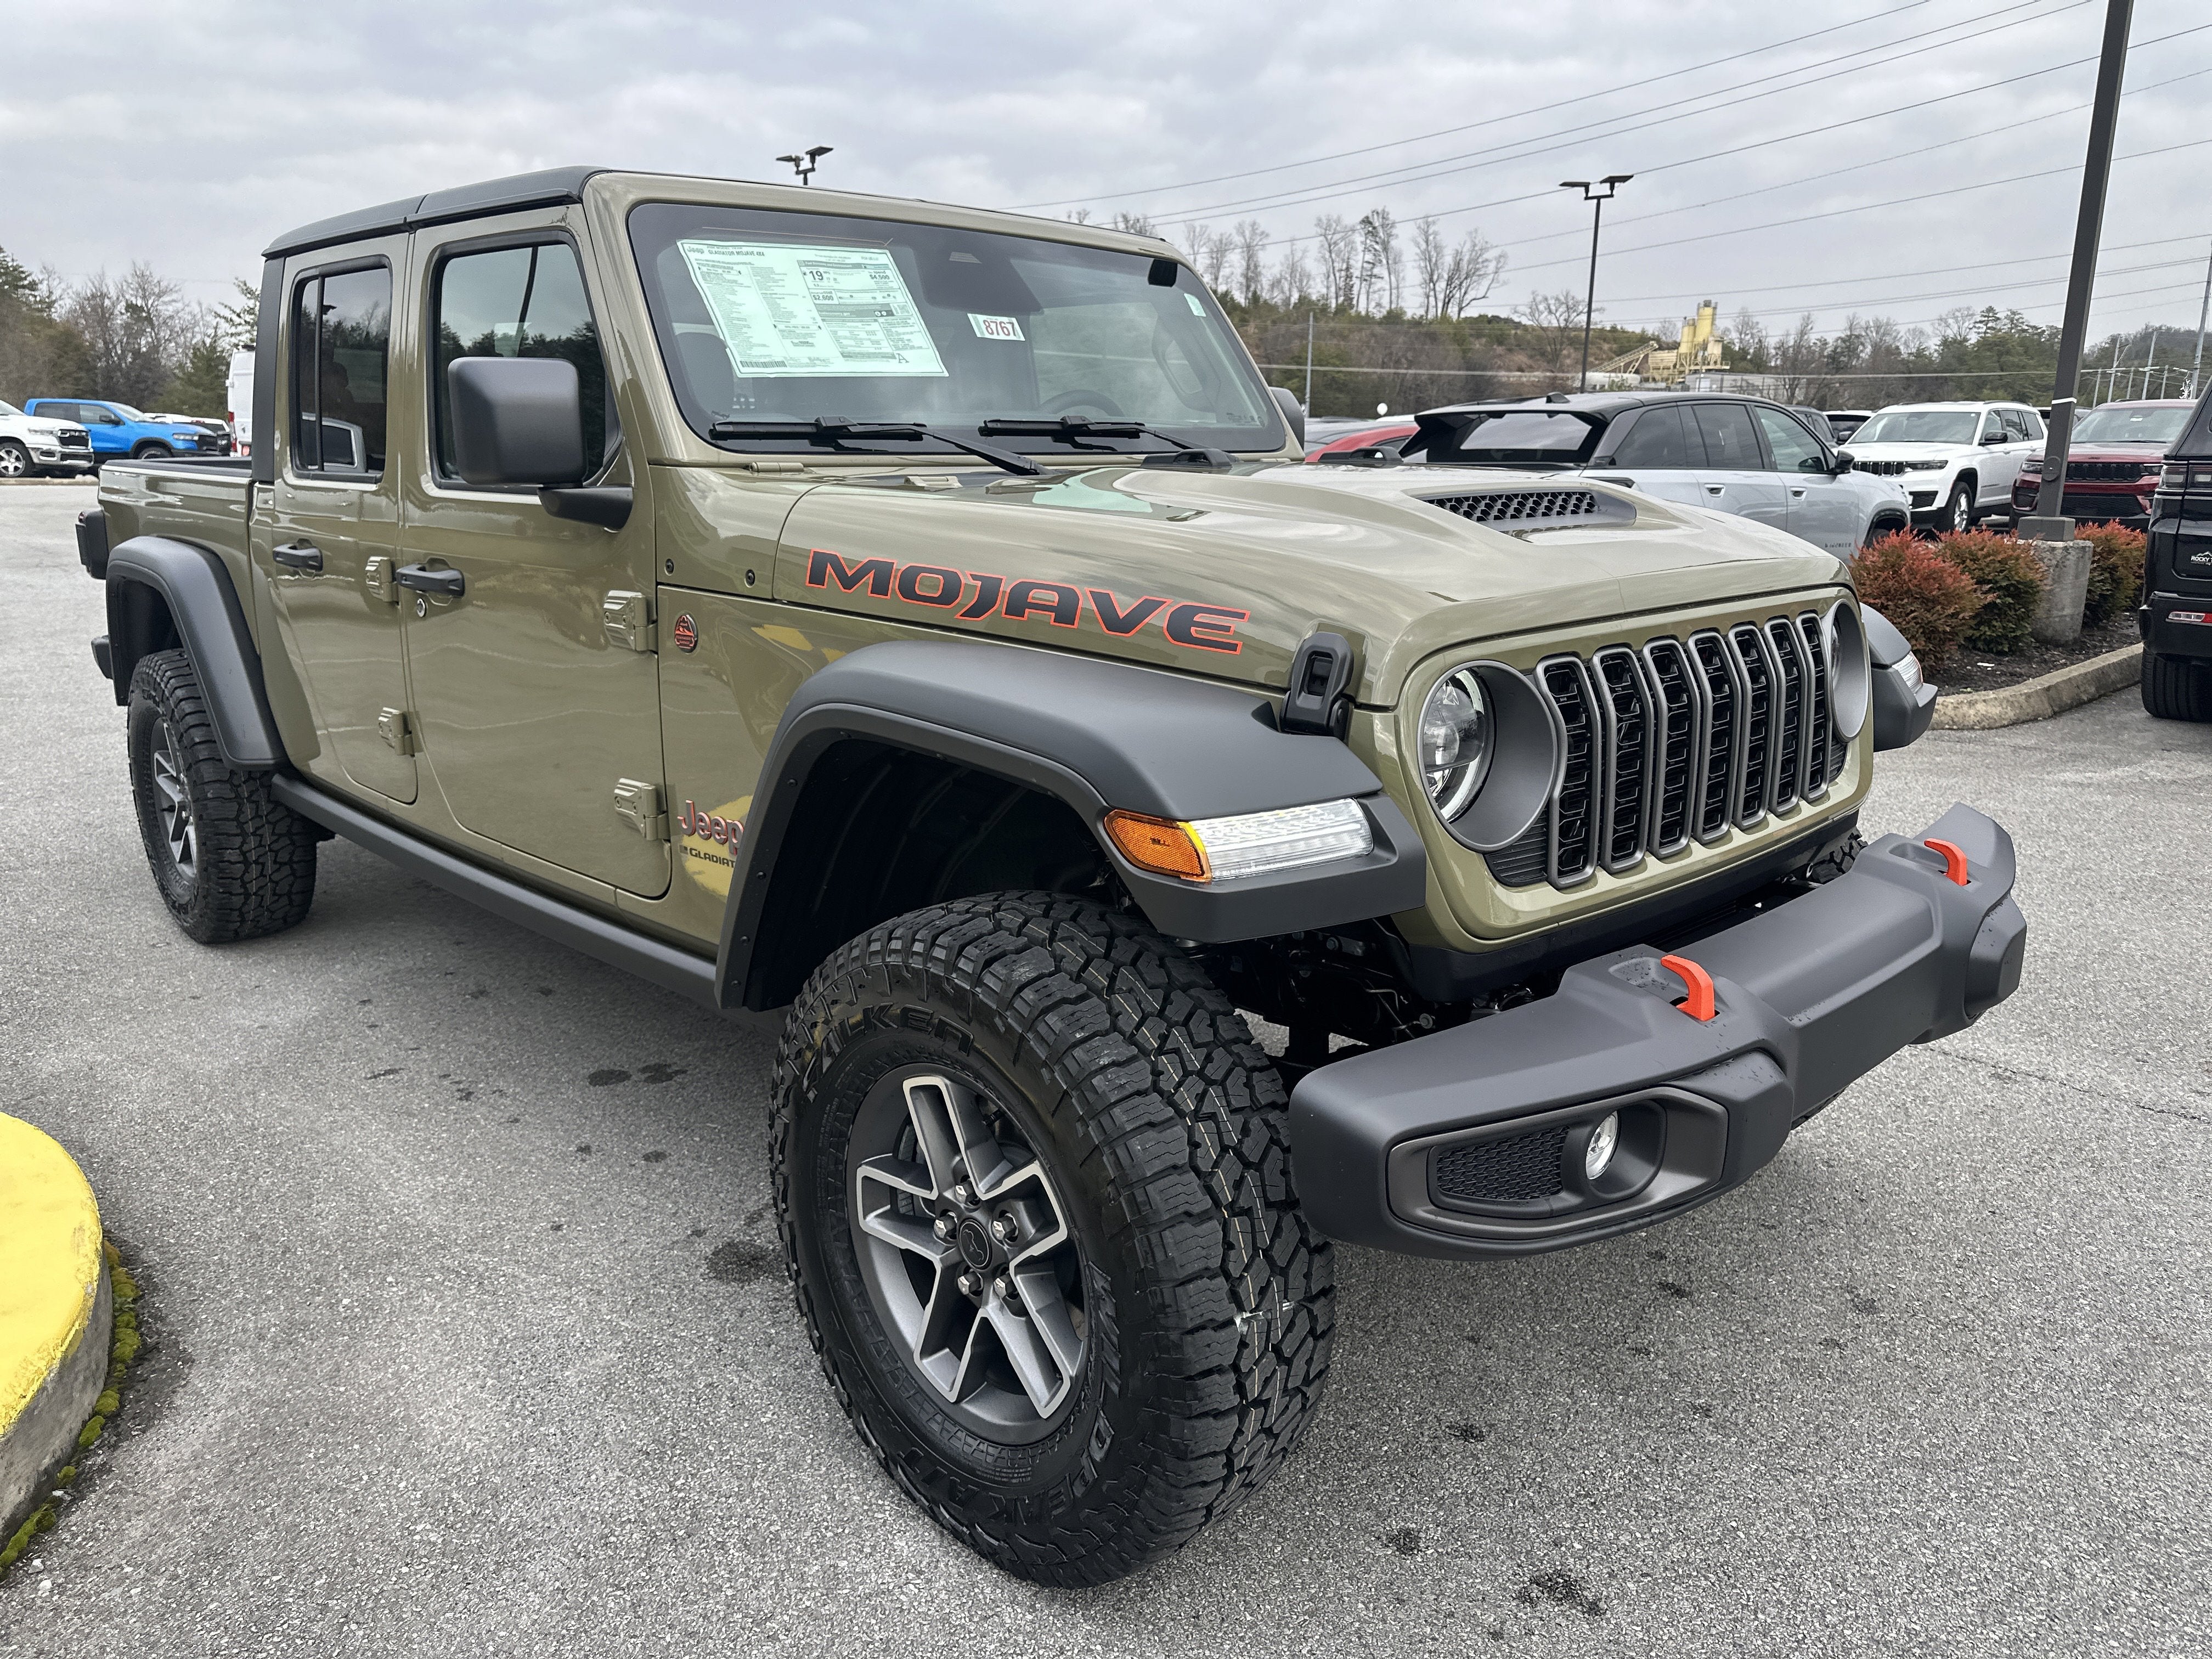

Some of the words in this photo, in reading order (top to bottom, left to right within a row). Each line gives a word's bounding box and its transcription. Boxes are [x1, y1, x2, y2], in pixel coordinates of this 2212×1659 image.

[687, 246, 705, 255] Jeep
[809, 270, 823, 281] 19
[983, 319, 1016, 337] 8767
[896, 353, 910, 364] A
[805, 549, 1251, 655] MOJAVE
[677, 799, 744, 856] Jeep
